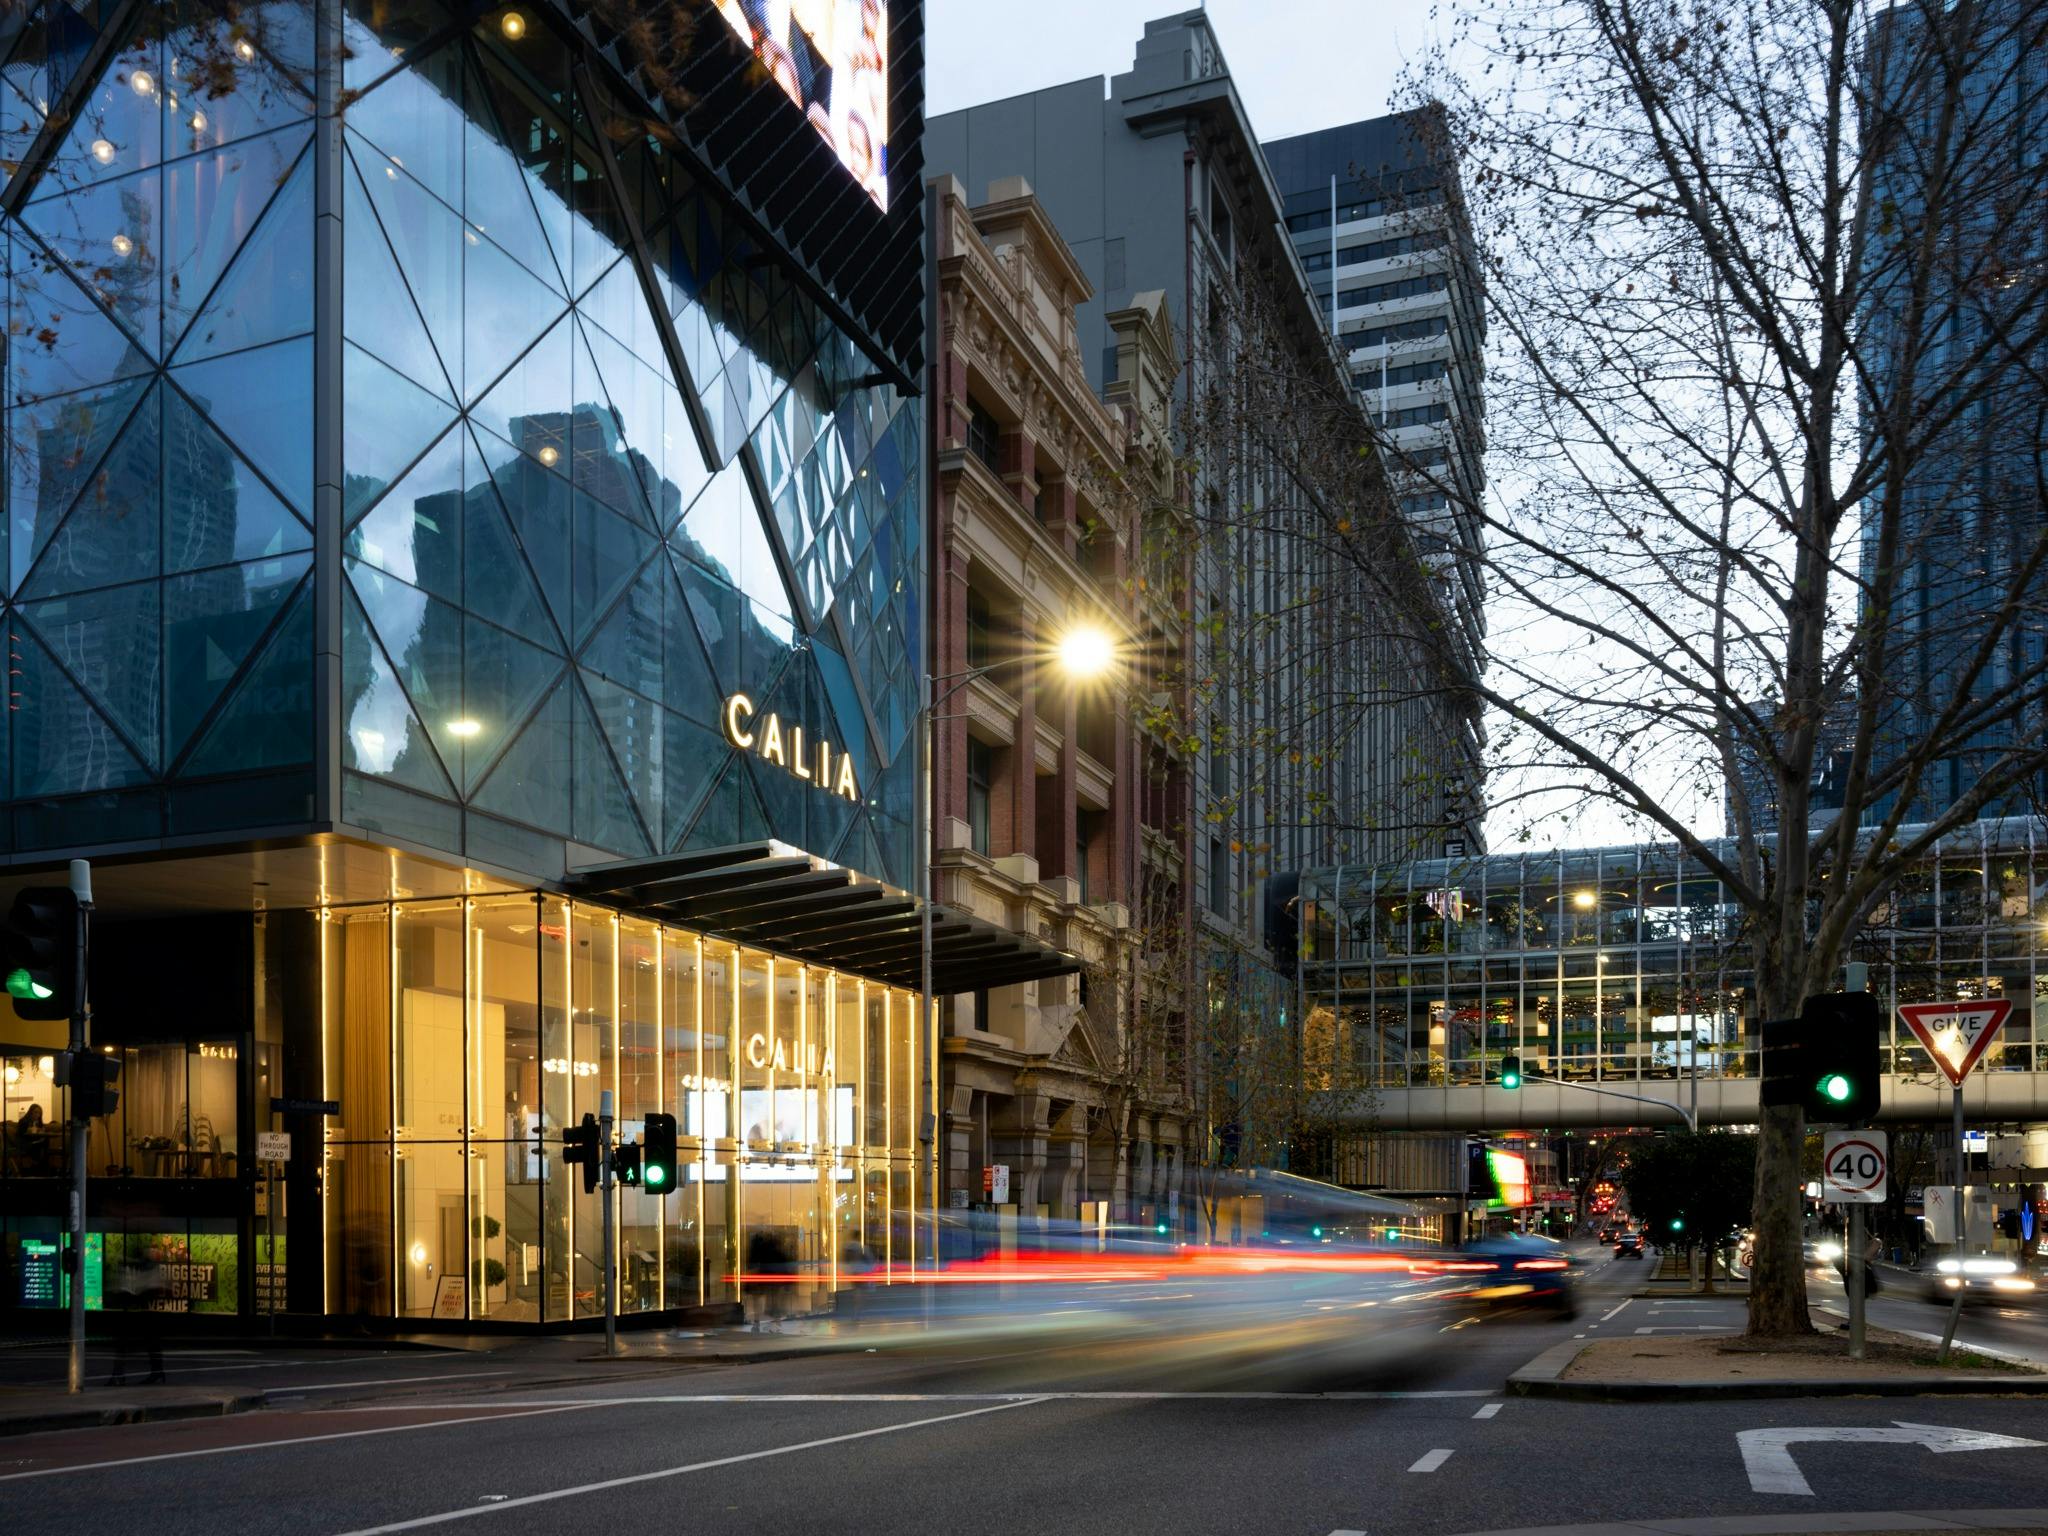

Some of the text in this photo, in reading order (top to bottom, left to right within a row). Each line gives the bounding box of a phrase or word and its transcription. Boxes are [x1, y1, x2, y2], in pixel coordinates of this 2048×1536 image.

[726, 693, 857, 802] CALIA
[1932, 1016, 1981, 1032] GIVE
[747, 1032, 835, 1078] CALIA
[260, 1142, 289, 1150] THROUGH
[1833, 1153, 1878, 1179] 40
[160, 1264, 214, 1282] BIGGEST
[172, 1282, 209, 1300] GAME
